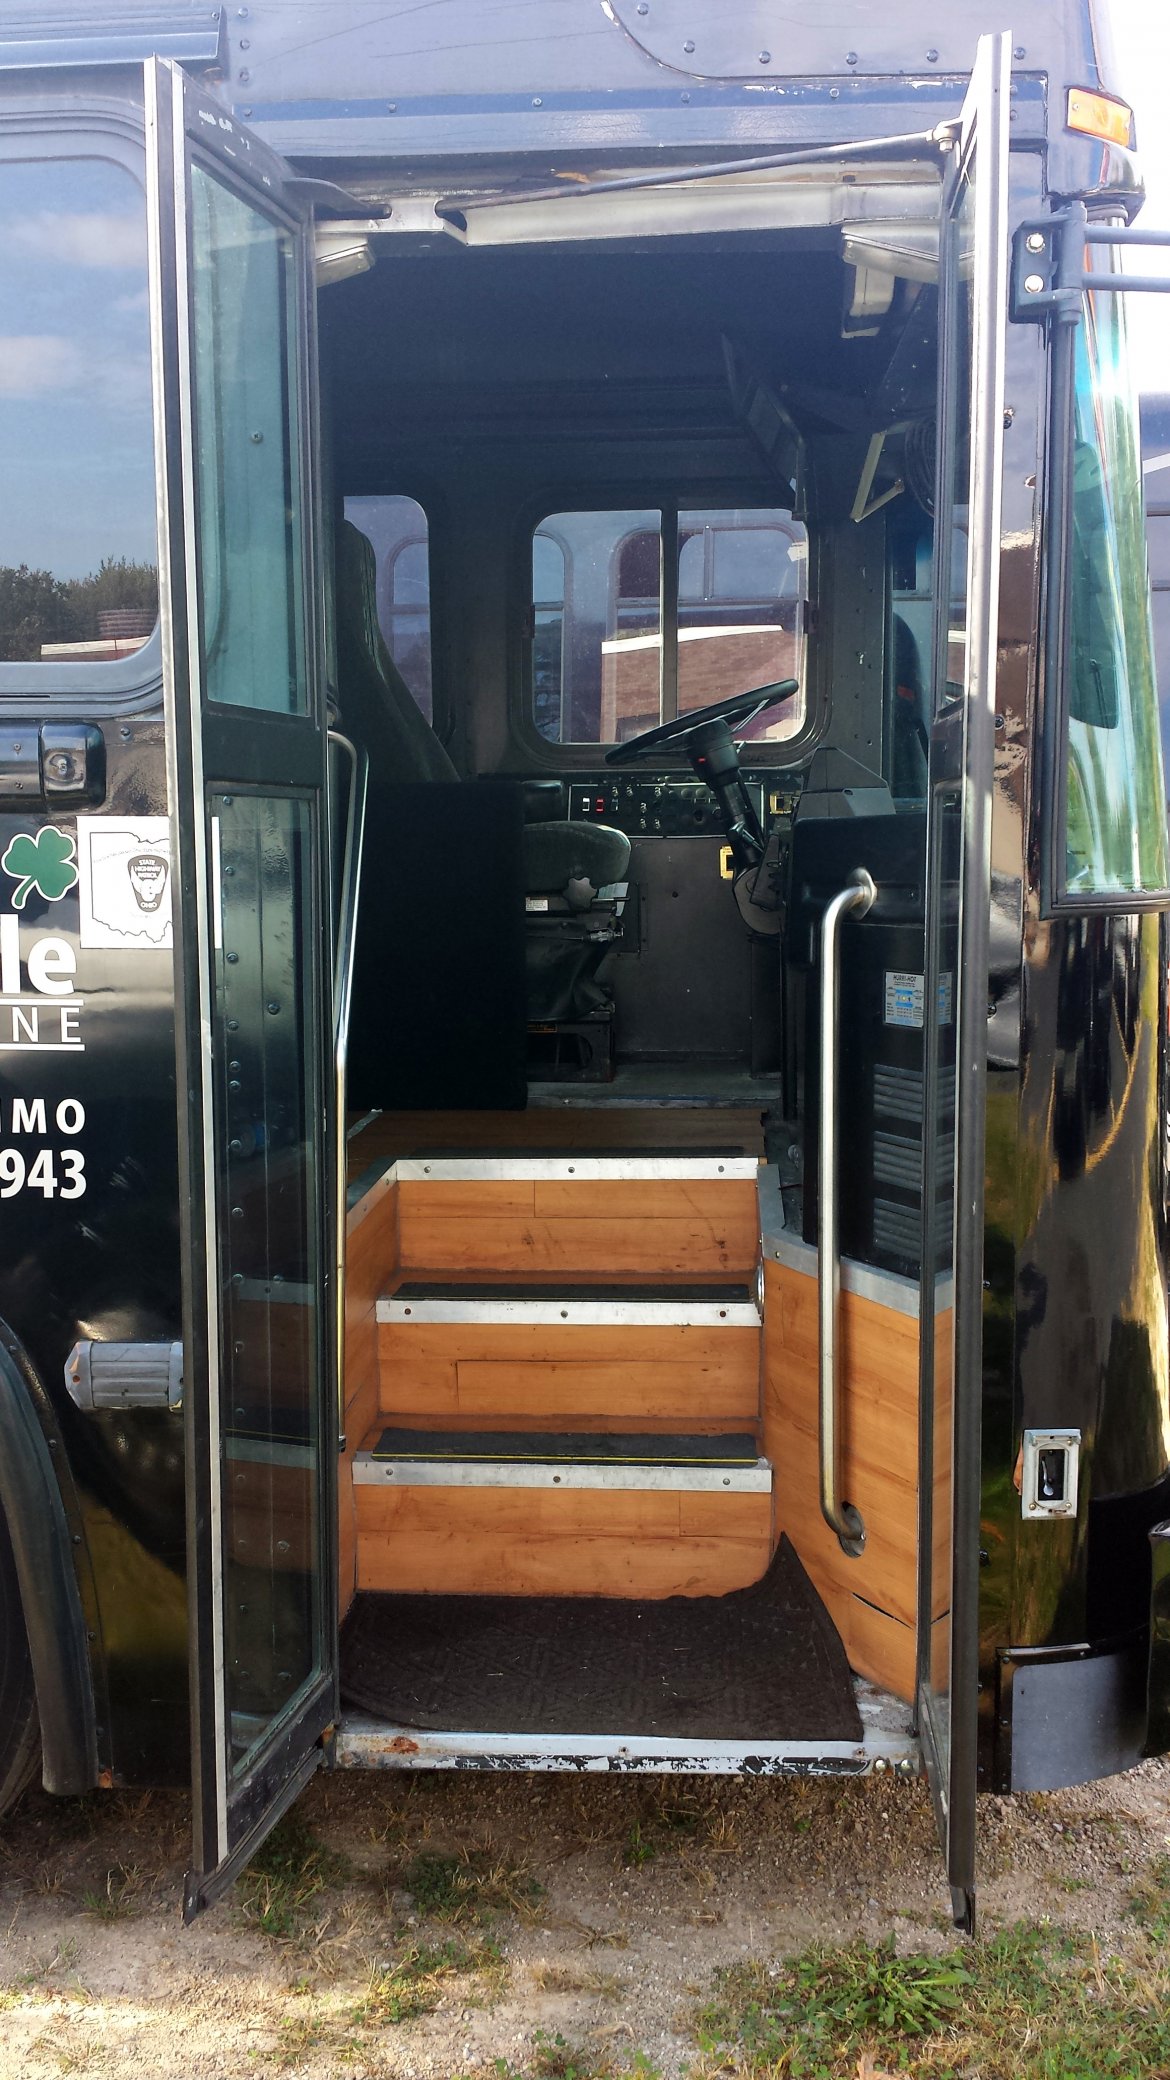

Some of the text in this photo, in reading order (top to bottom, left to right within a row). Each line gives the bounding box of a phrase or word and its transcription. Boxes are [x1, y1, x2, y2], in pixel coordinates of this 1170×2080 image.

[140, 901, 158, 909] OHIO
[0, 1098, 86, 1135] MO
[0, 1148, 87, 1199] 943
